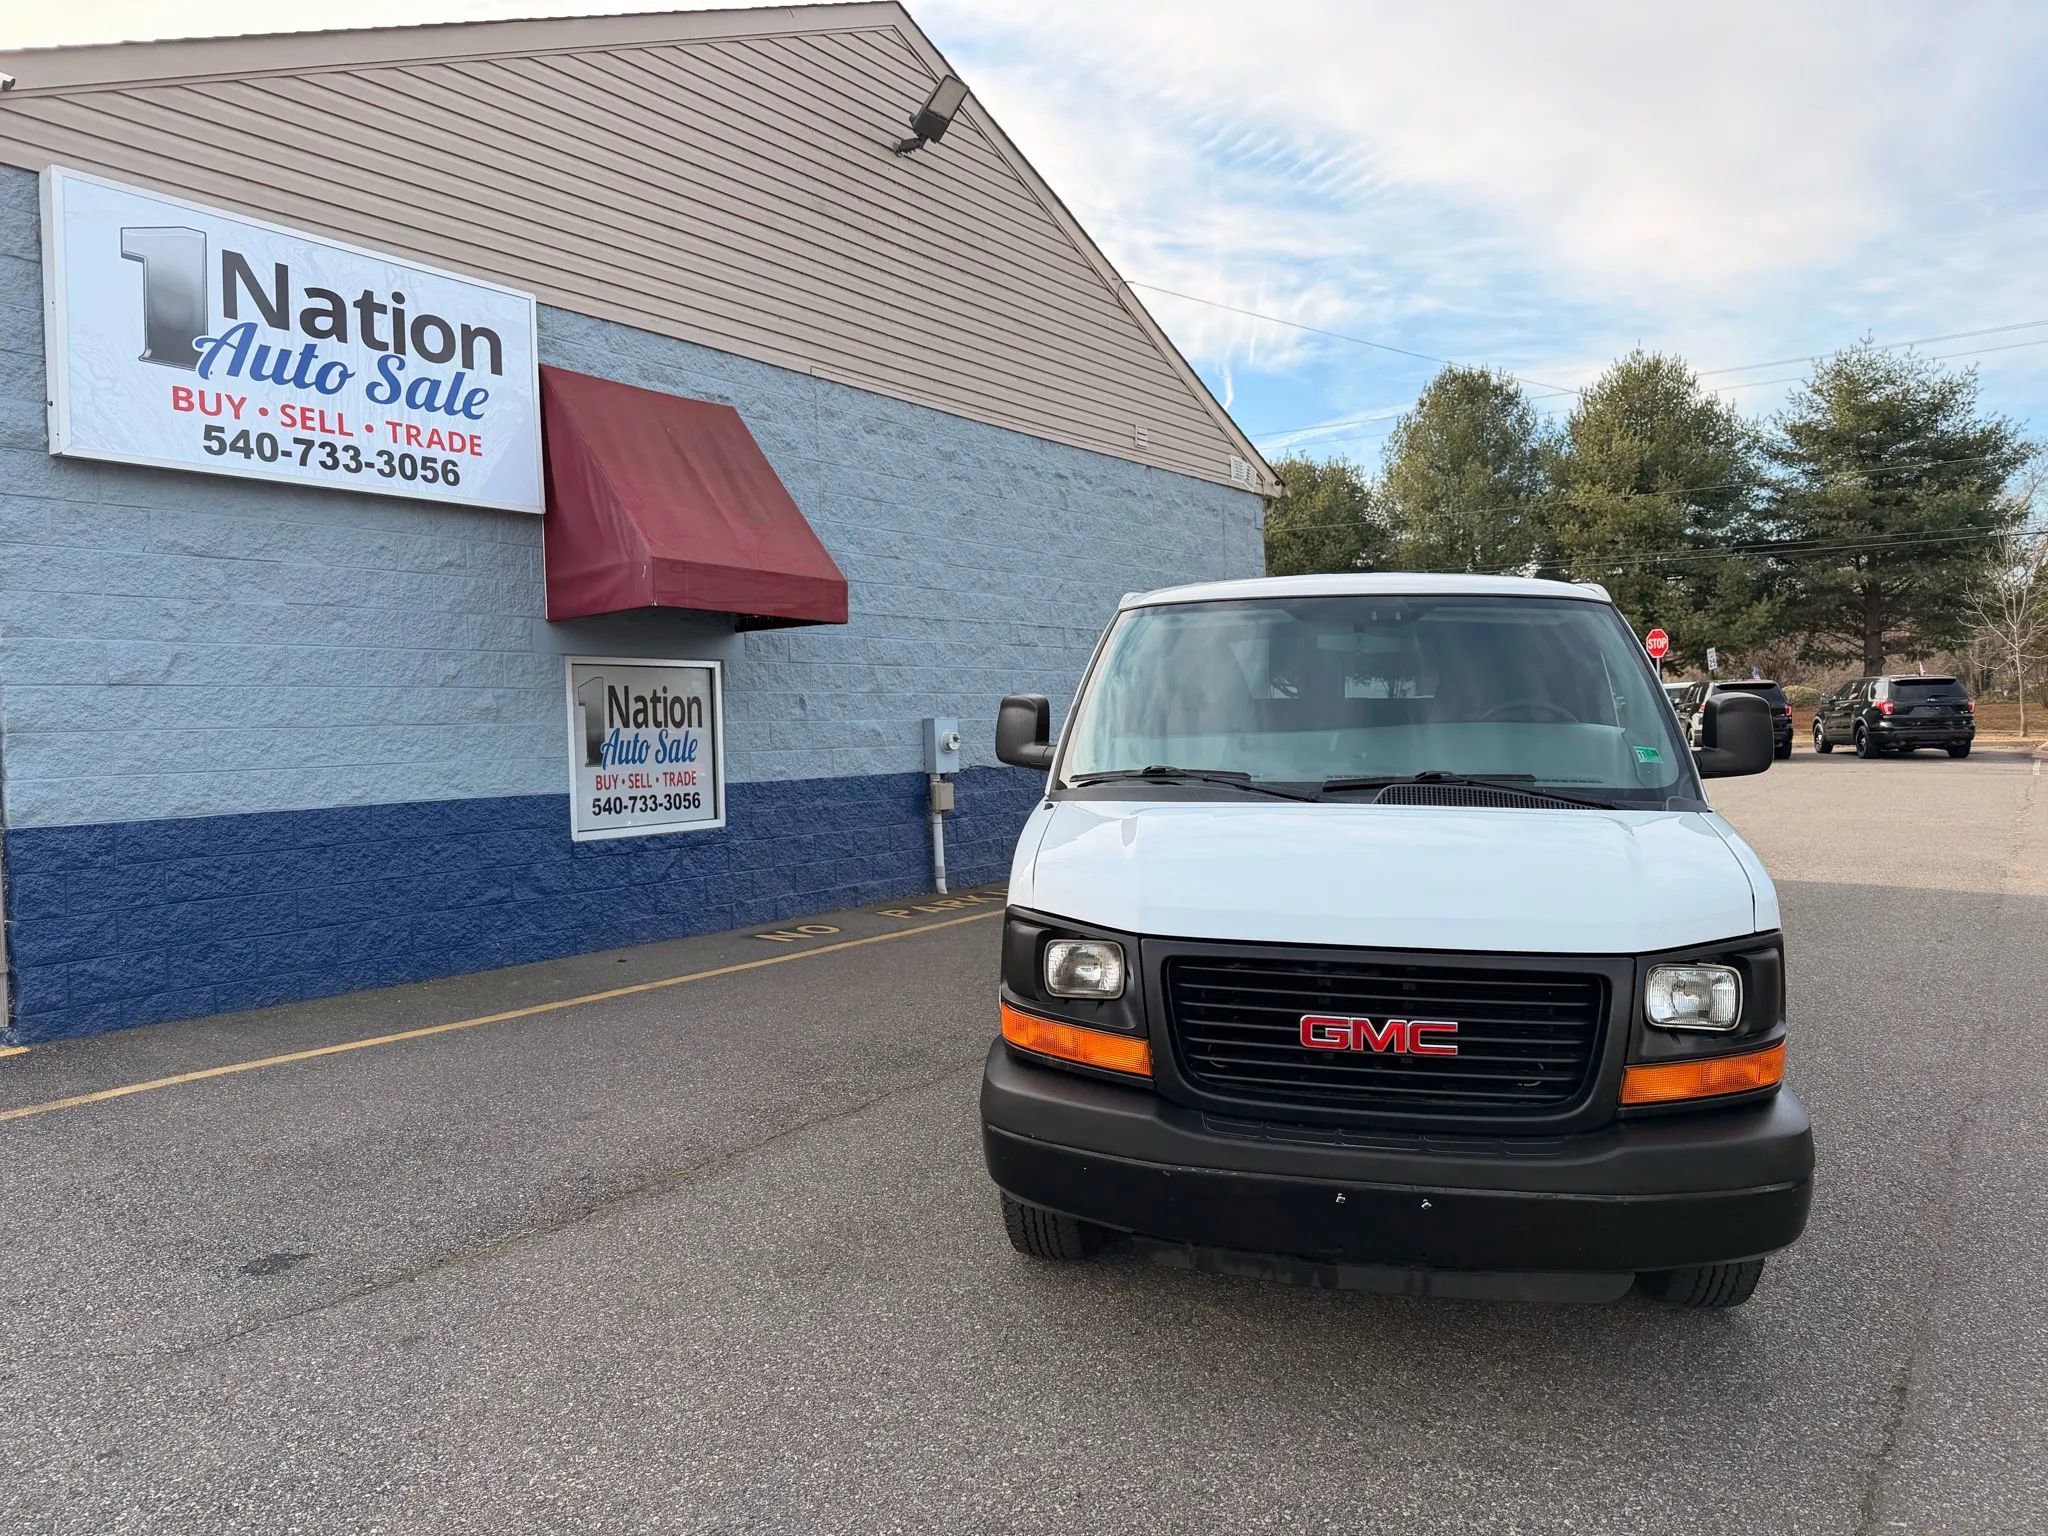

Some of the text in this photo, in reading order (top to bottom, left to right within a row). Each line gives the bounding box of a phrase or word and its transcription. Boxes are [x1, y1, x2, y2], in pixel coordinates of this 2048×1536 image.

[221, 248, 504, 376] Nation
[193, 321, 491, 421] Auto Sale
[171, 384, 483, 457] BUY SELL TRADE
[203, 424, 461, 487] 540-733-3056
[1648, 637, 1667, 649] STOP
[607, 685, 703, 729] Nation
[601, 728, 698, 770] Auto Sale
[595, 771, 697, 791] BUY SELL TRADE
[592, 792, 701, 816] 540-733-3056
[753, 924, 841, 942] NO
[1300, 1014, 1458, 1056] GMC
